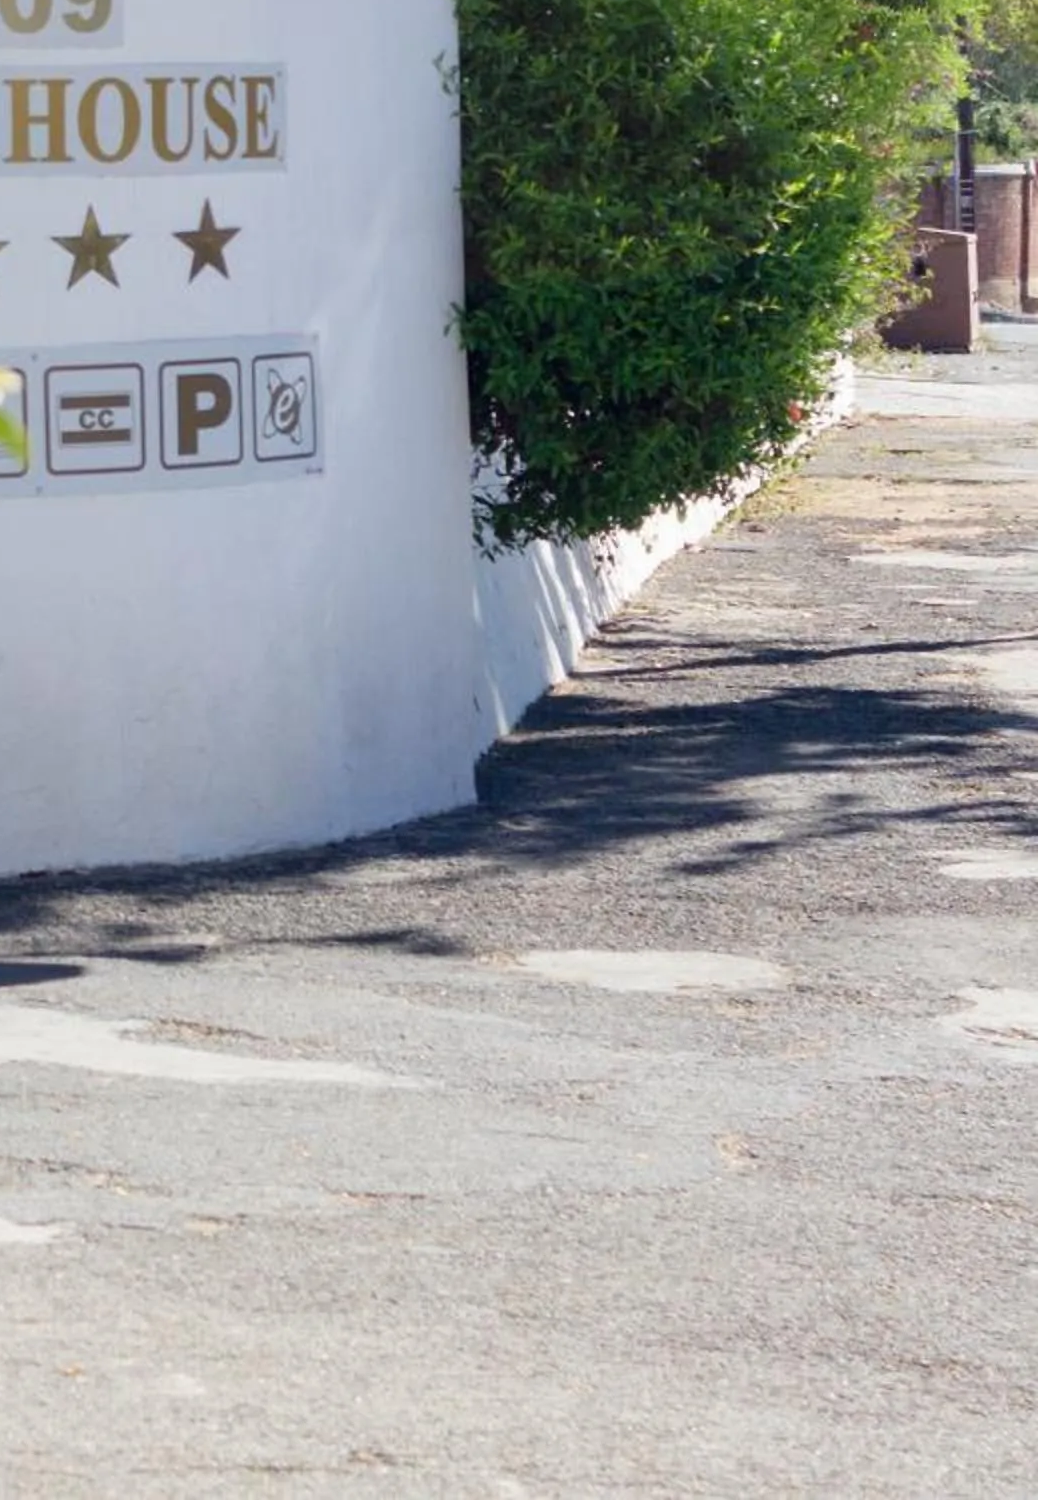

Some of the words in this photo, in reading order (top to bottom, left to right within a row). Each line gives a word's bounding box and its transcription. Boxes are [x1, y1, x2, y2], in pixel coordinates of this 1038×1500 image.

[2, 74, 280, 164] HOUSE
[79, 409, 115, 430] CC
[177, 373, 233, 456] P
